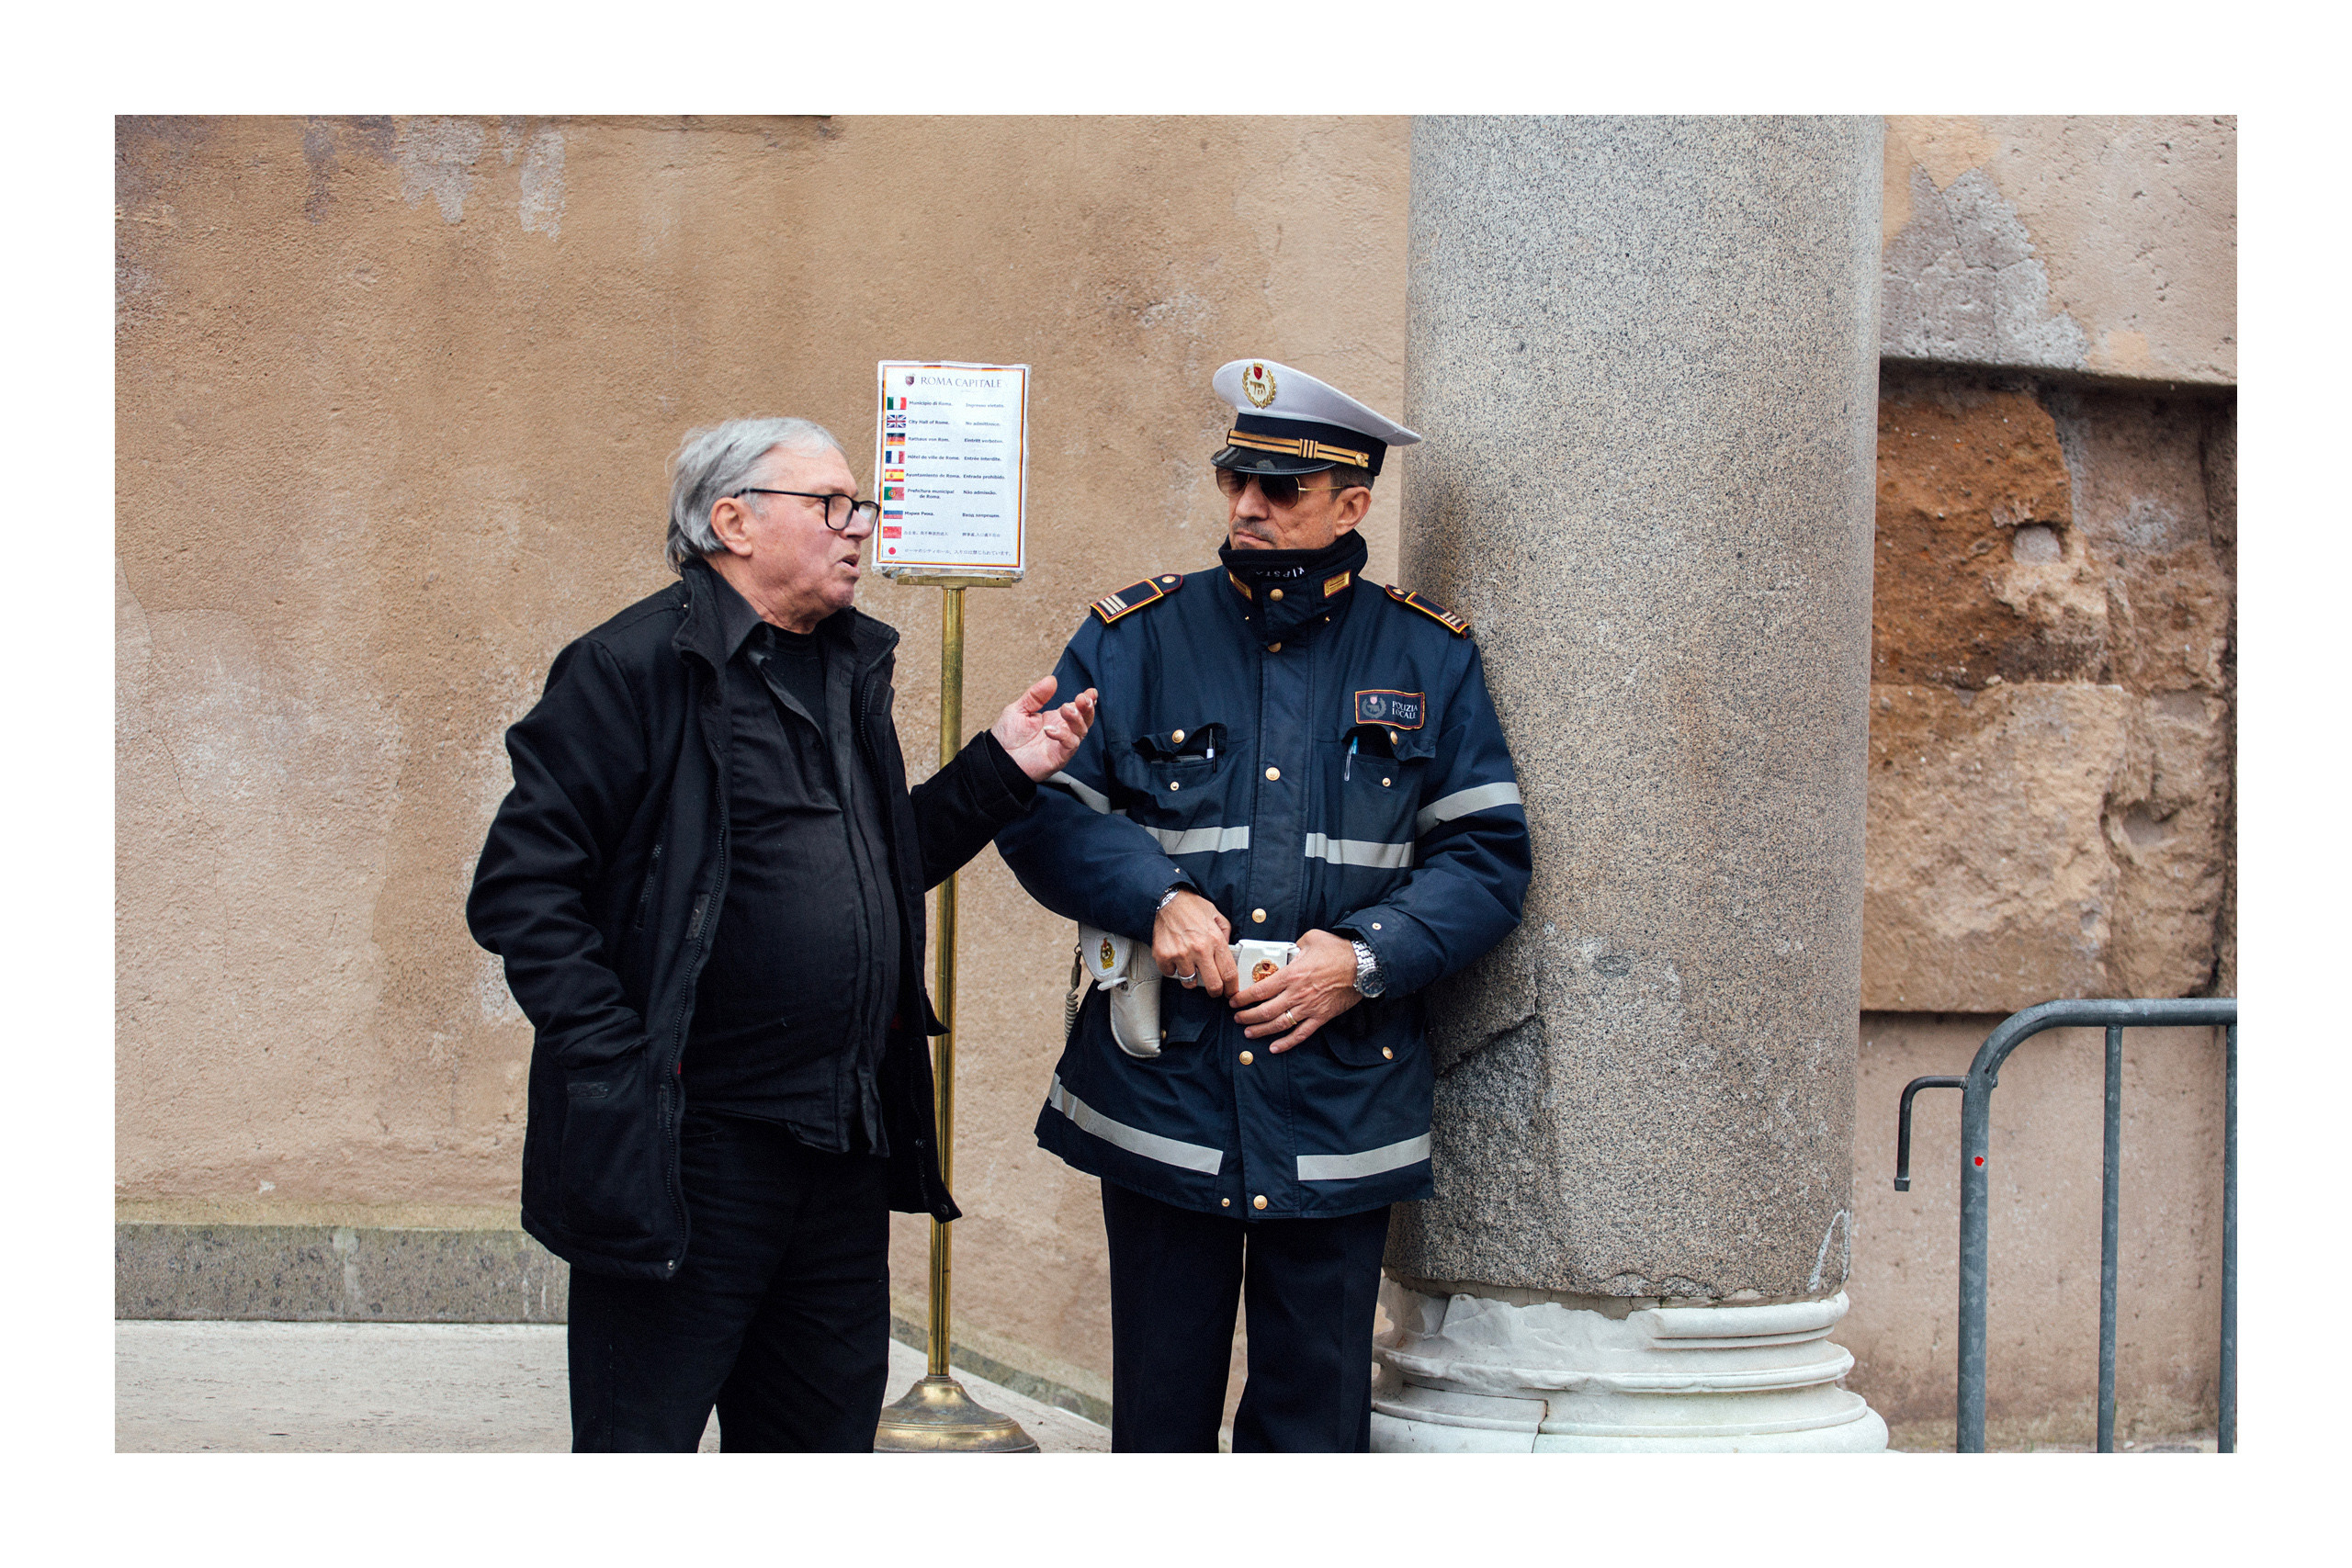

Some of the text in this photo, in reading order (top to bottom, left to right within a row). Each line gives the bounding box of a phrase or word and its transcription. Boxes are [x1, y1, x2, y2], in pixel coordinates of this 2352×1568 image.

[921, 377, 1002, 389] ROMA CAPITALE
[1392, 701, 1418, 712] POLIZIA
[1392, 707, 1416, 719] LOCALE
